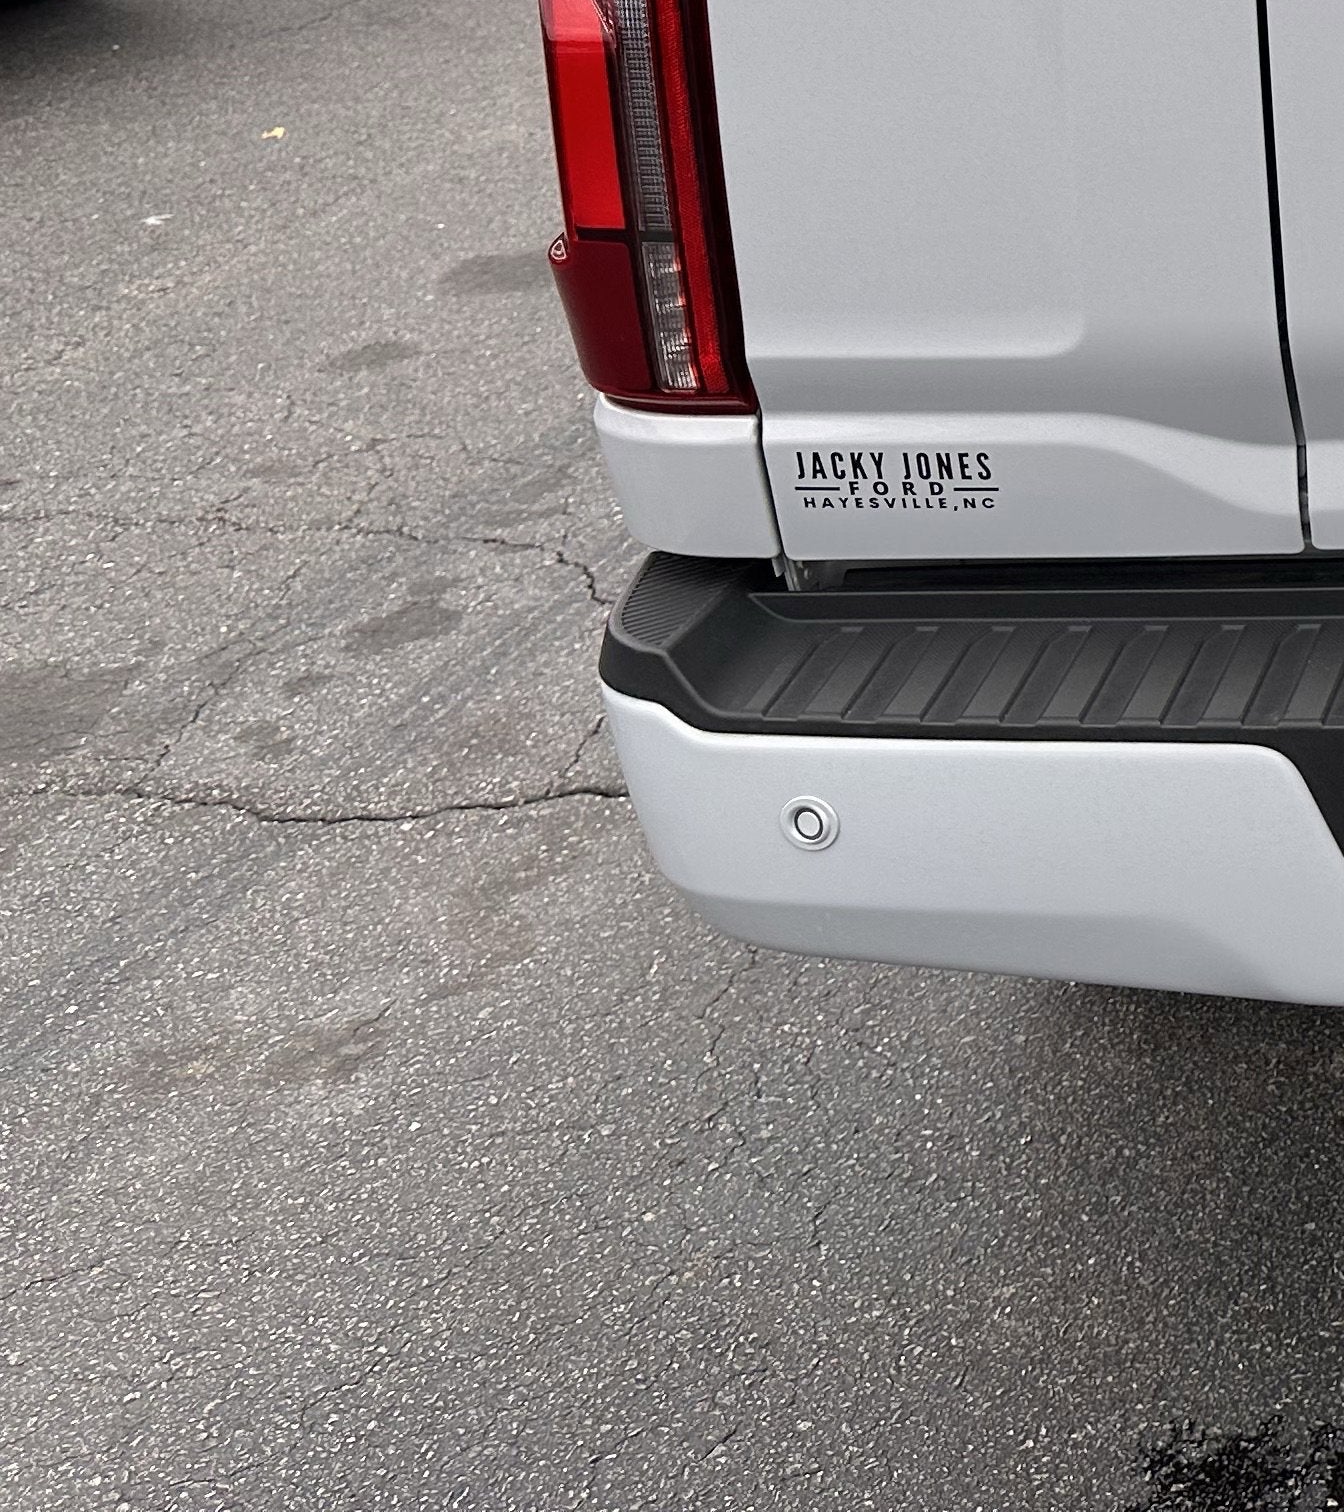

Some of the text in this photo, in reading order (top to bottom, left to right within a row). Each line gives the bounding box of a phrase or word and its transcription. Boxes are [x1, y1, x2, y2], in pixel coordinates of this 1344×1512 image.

[796, 451, 992, 481] JACKY JONES
[849, 481, 944, 496] FORD
